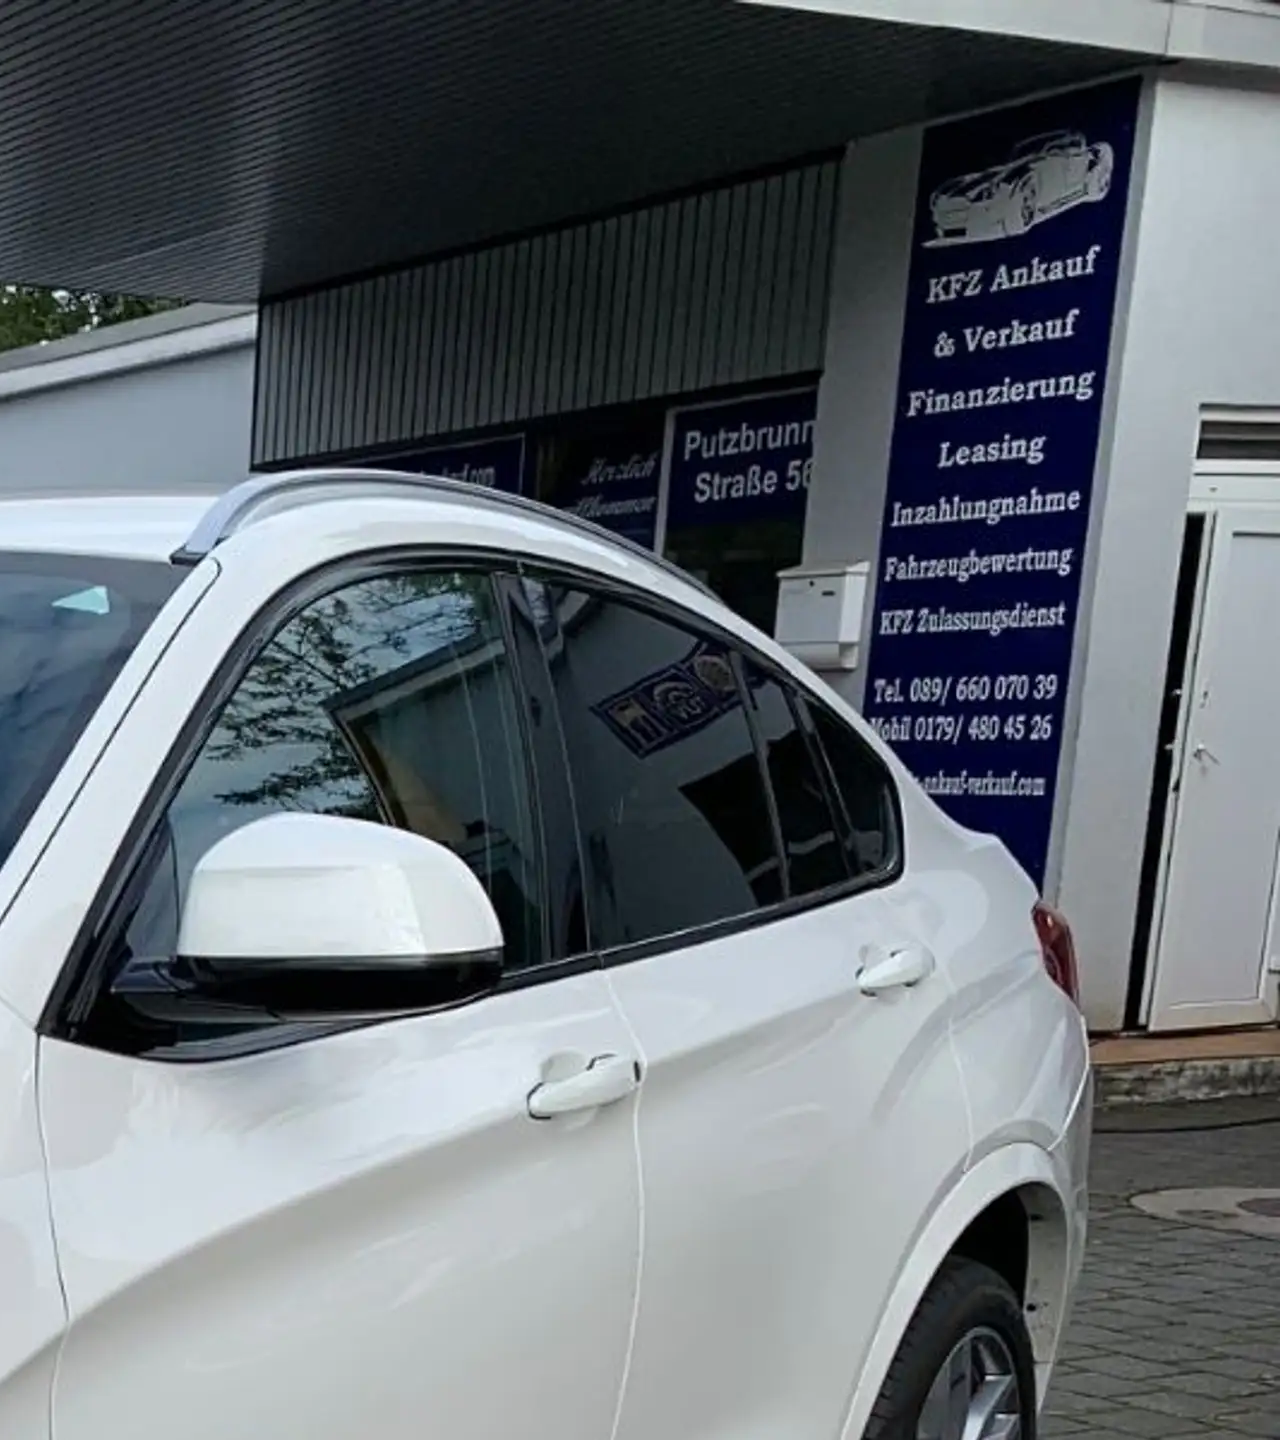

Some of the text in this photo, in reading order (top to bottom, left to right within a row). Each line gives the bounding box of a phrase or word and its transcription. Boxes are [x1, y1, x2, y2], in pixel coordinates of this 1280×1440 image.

[926, 245, 1101, 303] KFZ Ankauf
[934, 309, 1080, 357] & Verkauf
[907, 370, 1096, 417] Finanzierung
[938, 435, 1046, 467] Leasing
[694, 464, 778, 503] Straße
[891, 488, 1080, 526] Inzahlungnahme
[884, 547, 1073, 581] Fahrzeugbewertung
[880, 602, 1066, 636] KFZ Zulassungsdienst
[874, 674, 1058, 706] Tel. 089/ 660 070 39
[915, 714, 964, 745] 0179/
[968, 715, 1000, 741] 480
[1004, 715, 1026, 740] 45
[1030, 714, 1053, 740] 26
